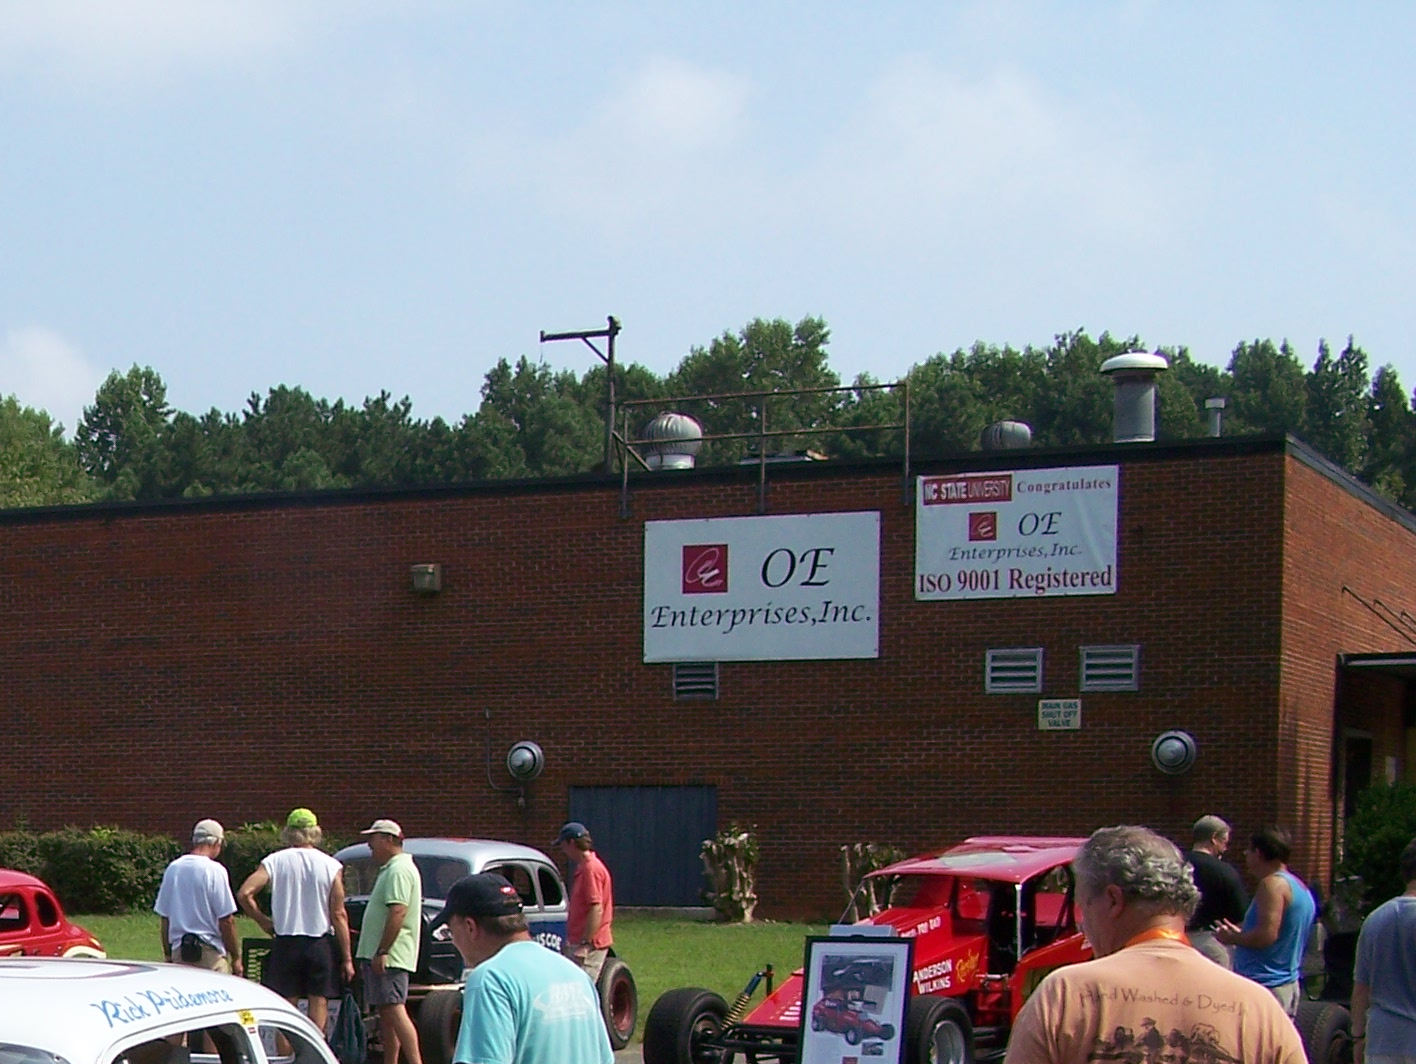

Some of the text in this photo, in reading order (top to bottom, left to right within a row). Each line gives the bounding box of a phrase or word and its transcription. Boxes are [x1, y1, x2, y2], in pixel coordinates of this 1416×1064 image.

[941, 483, 967, 499] STATE
[968, 480, 1010, 498] UNIVERSITY
[1017, 479, 1112, 494] Congratulates
[1018, 512, 1062, 536] OE
[762, 548, 835, 588] OE
[919, 565, 1112, 593] ISO 9001 Registered
[913, 958, 953, 983] ANDERSON
[918, 976, 952, 994] WILKINS
[1121, 988, 1179, 1006] Washed
[1197, 994, 1235, 1013] Dyed
